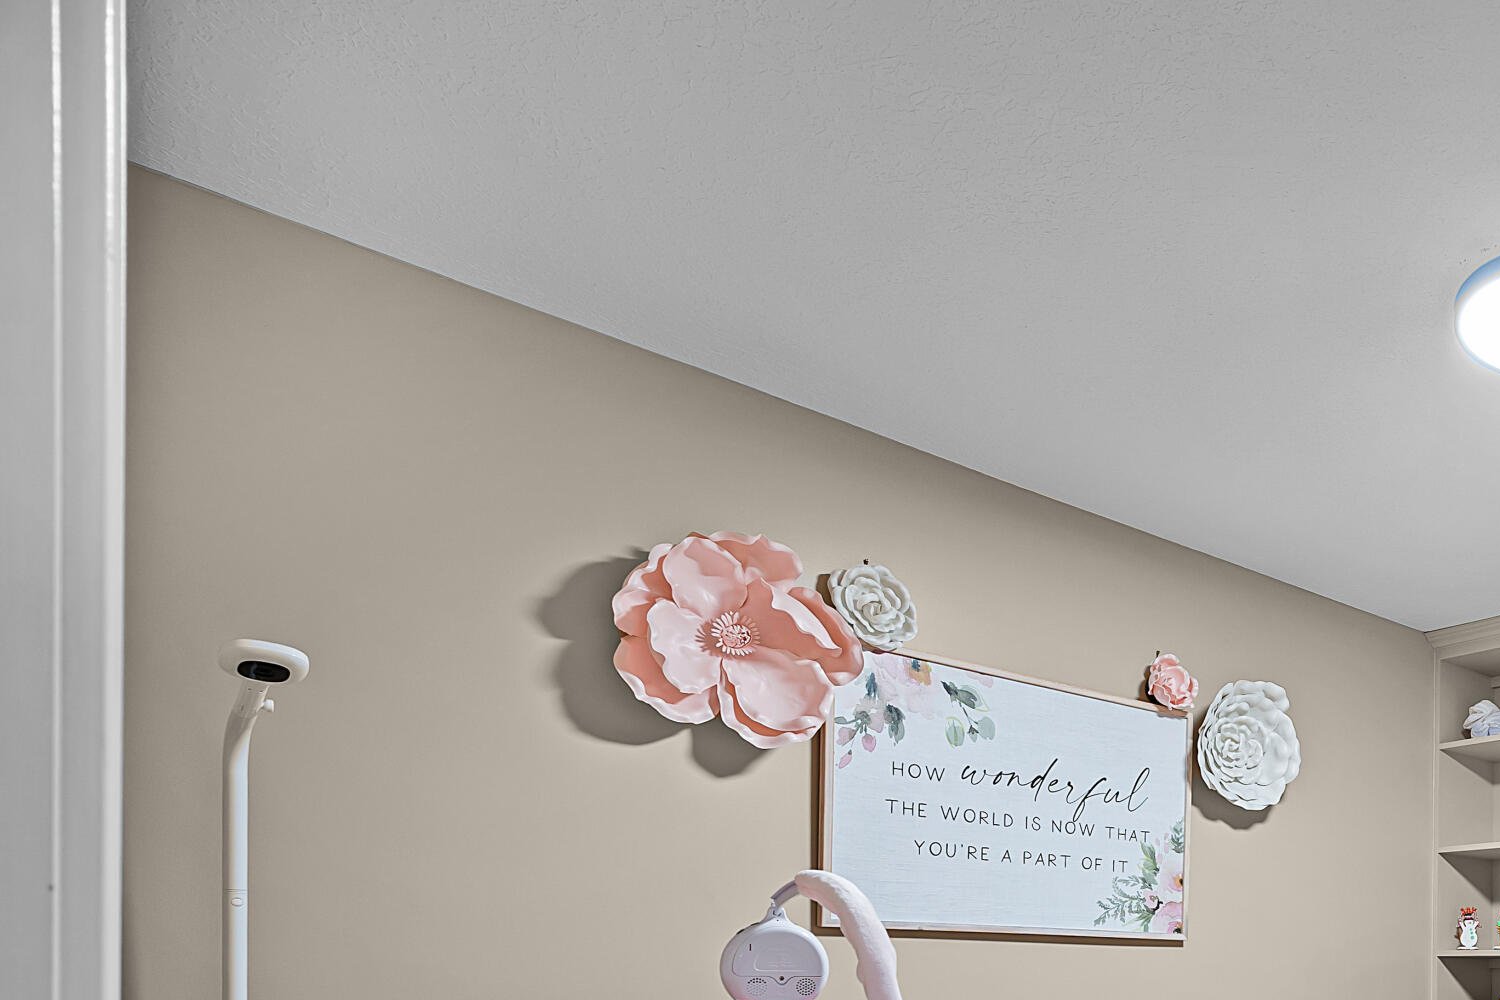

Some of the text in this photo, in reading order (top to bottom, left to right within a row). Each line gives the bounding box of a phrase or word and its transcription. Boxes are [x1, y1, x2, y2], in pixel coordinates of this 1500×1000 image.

[892, 757, 1151, 823] HOW wonderful
[885, 798, 1150, 843] THE WORLD IS NOW THAT
[914, 839, 1129, 873] YOU'RE A PART OF IT
